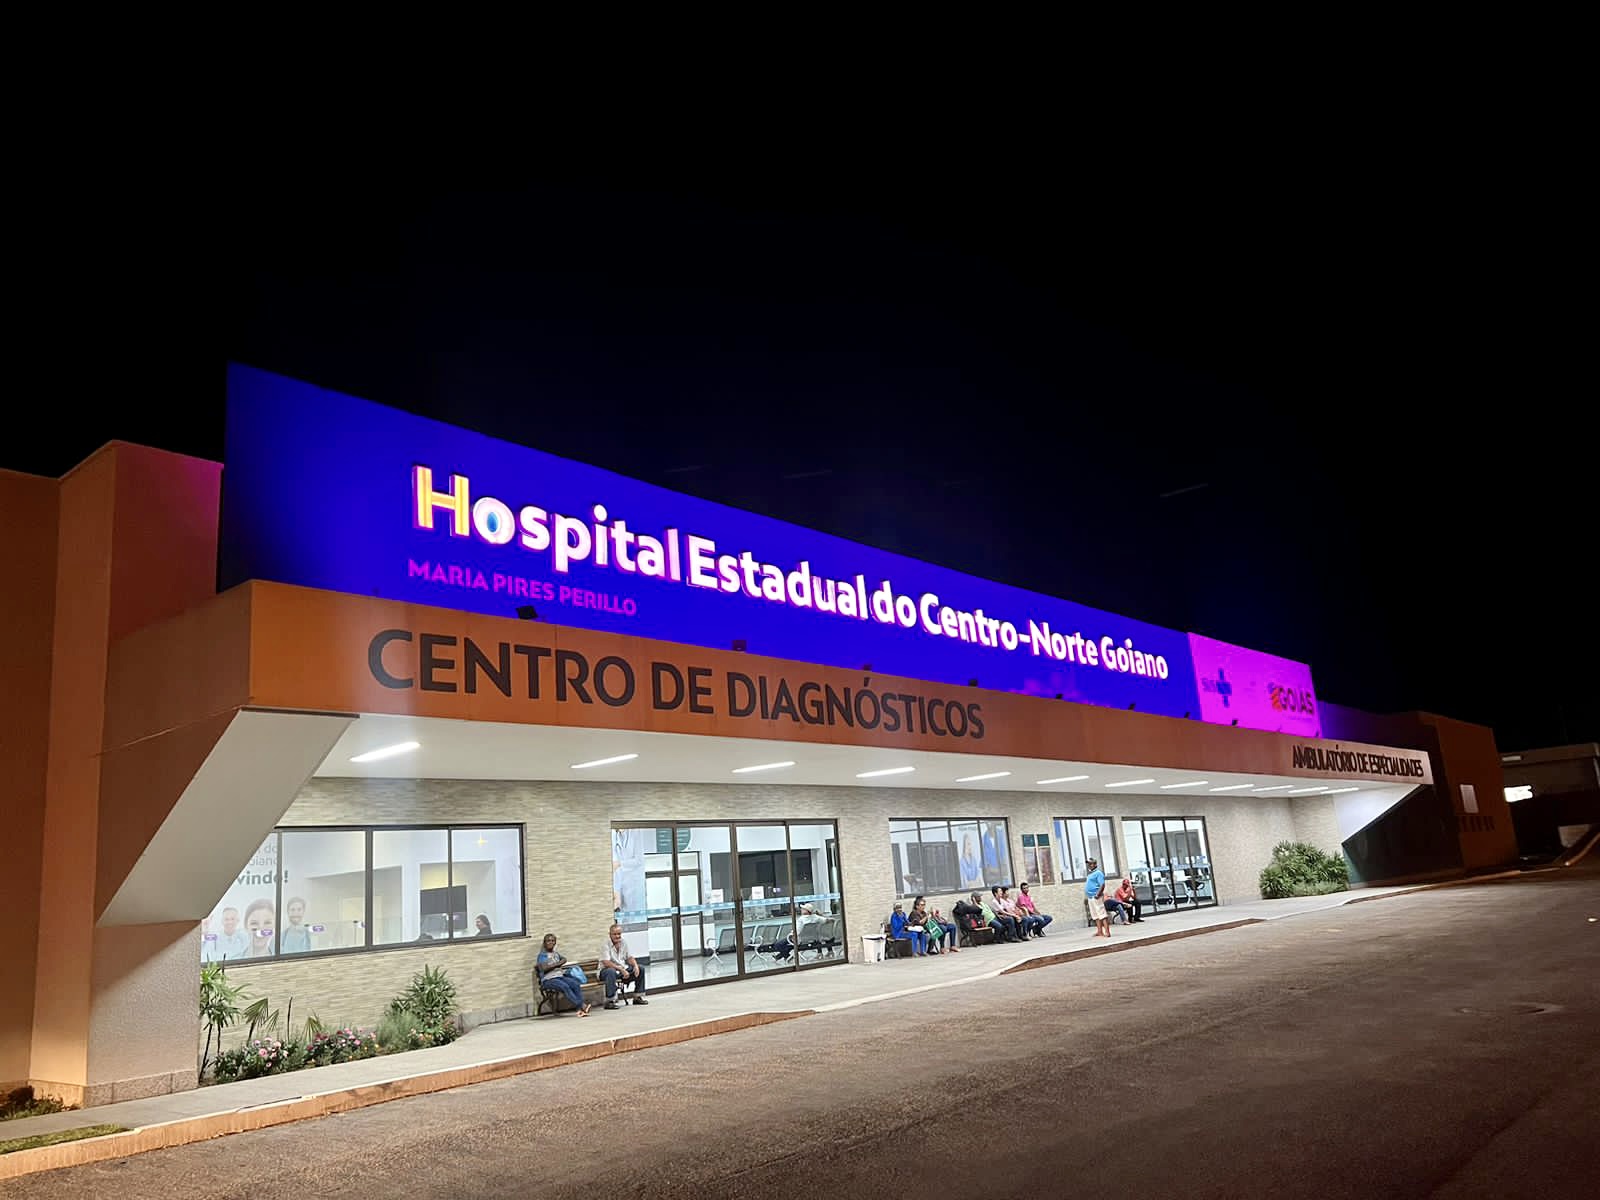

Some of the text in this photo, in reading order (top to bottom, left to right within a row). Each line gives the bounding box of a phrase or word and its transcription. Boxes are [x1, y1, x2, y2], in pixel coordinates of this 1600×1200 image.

[408, 559, 637, 617] MARIA PIRES PERILLO
[411, 465, 1168, 679] Hospital Estadual do Centro-Norte Goiano
[368, 629, 984, 739] CENTRO DE DIAGNÓSTICOS
[1293, 744, 1357, 772] AMBULATÓRIO
[1356, 752, 1370, 773] DE
